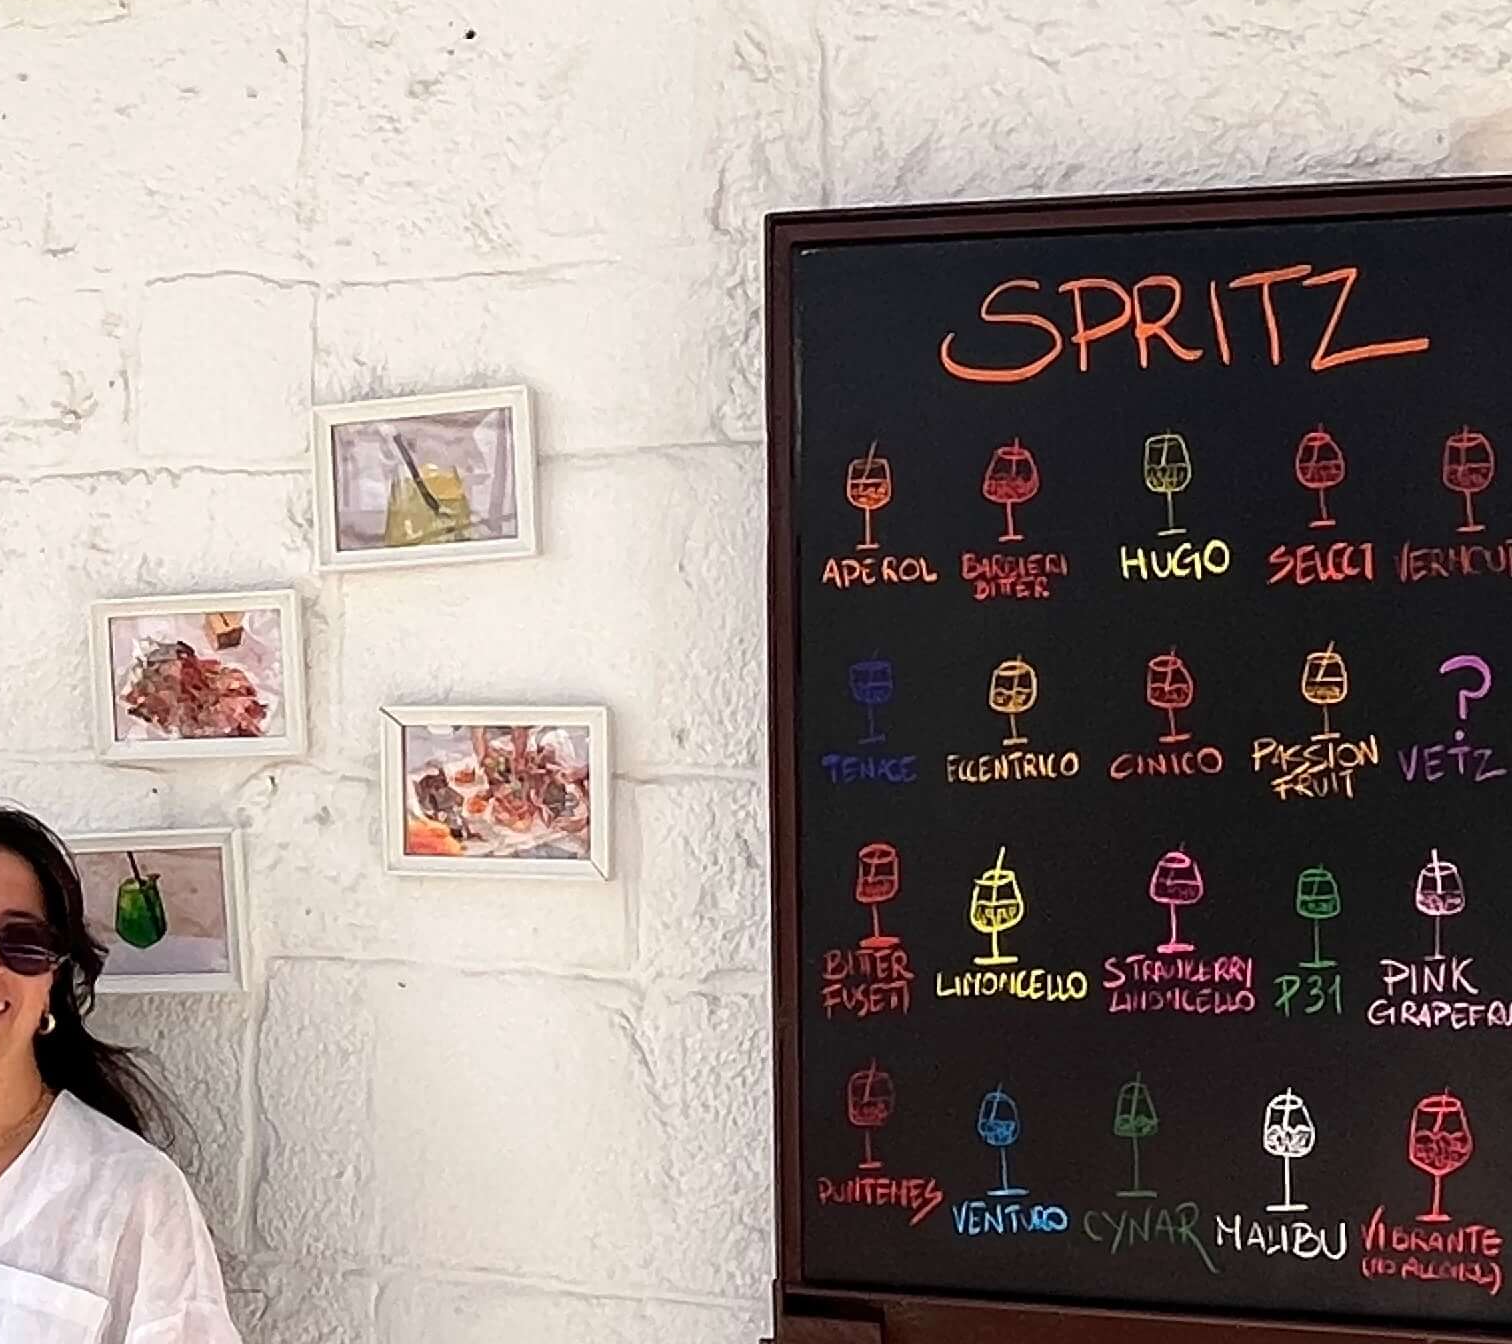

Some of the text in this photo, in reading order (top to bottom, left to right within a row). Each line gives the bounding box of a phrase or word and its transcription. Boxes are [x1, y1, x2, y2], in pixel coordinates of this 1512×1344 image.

[941, 264, 1429, 383] SPRITZ
[822, 556, 938, 589] APEROL
[1120, 539, 1230, 580] HUGO
[1110, 747, 1223, 780] CINICO
[1252, 733, 1380, 775] PASSION
[1271, 767, 1355, 801] FRUIT
[822, 949, 915, 980] BITTER
[1379, 957, 1479, 997] PINK
[937, 969, 1088, 1002] LIMONCELLO
[1273, 973, 1342, 1018] P31
[1083, 1201, 1221, 1274] CYNAR
[1215, 1213, 1347, 1260] MALIBU
[1361, 1205, 1504, 1256] VIBRANTE
